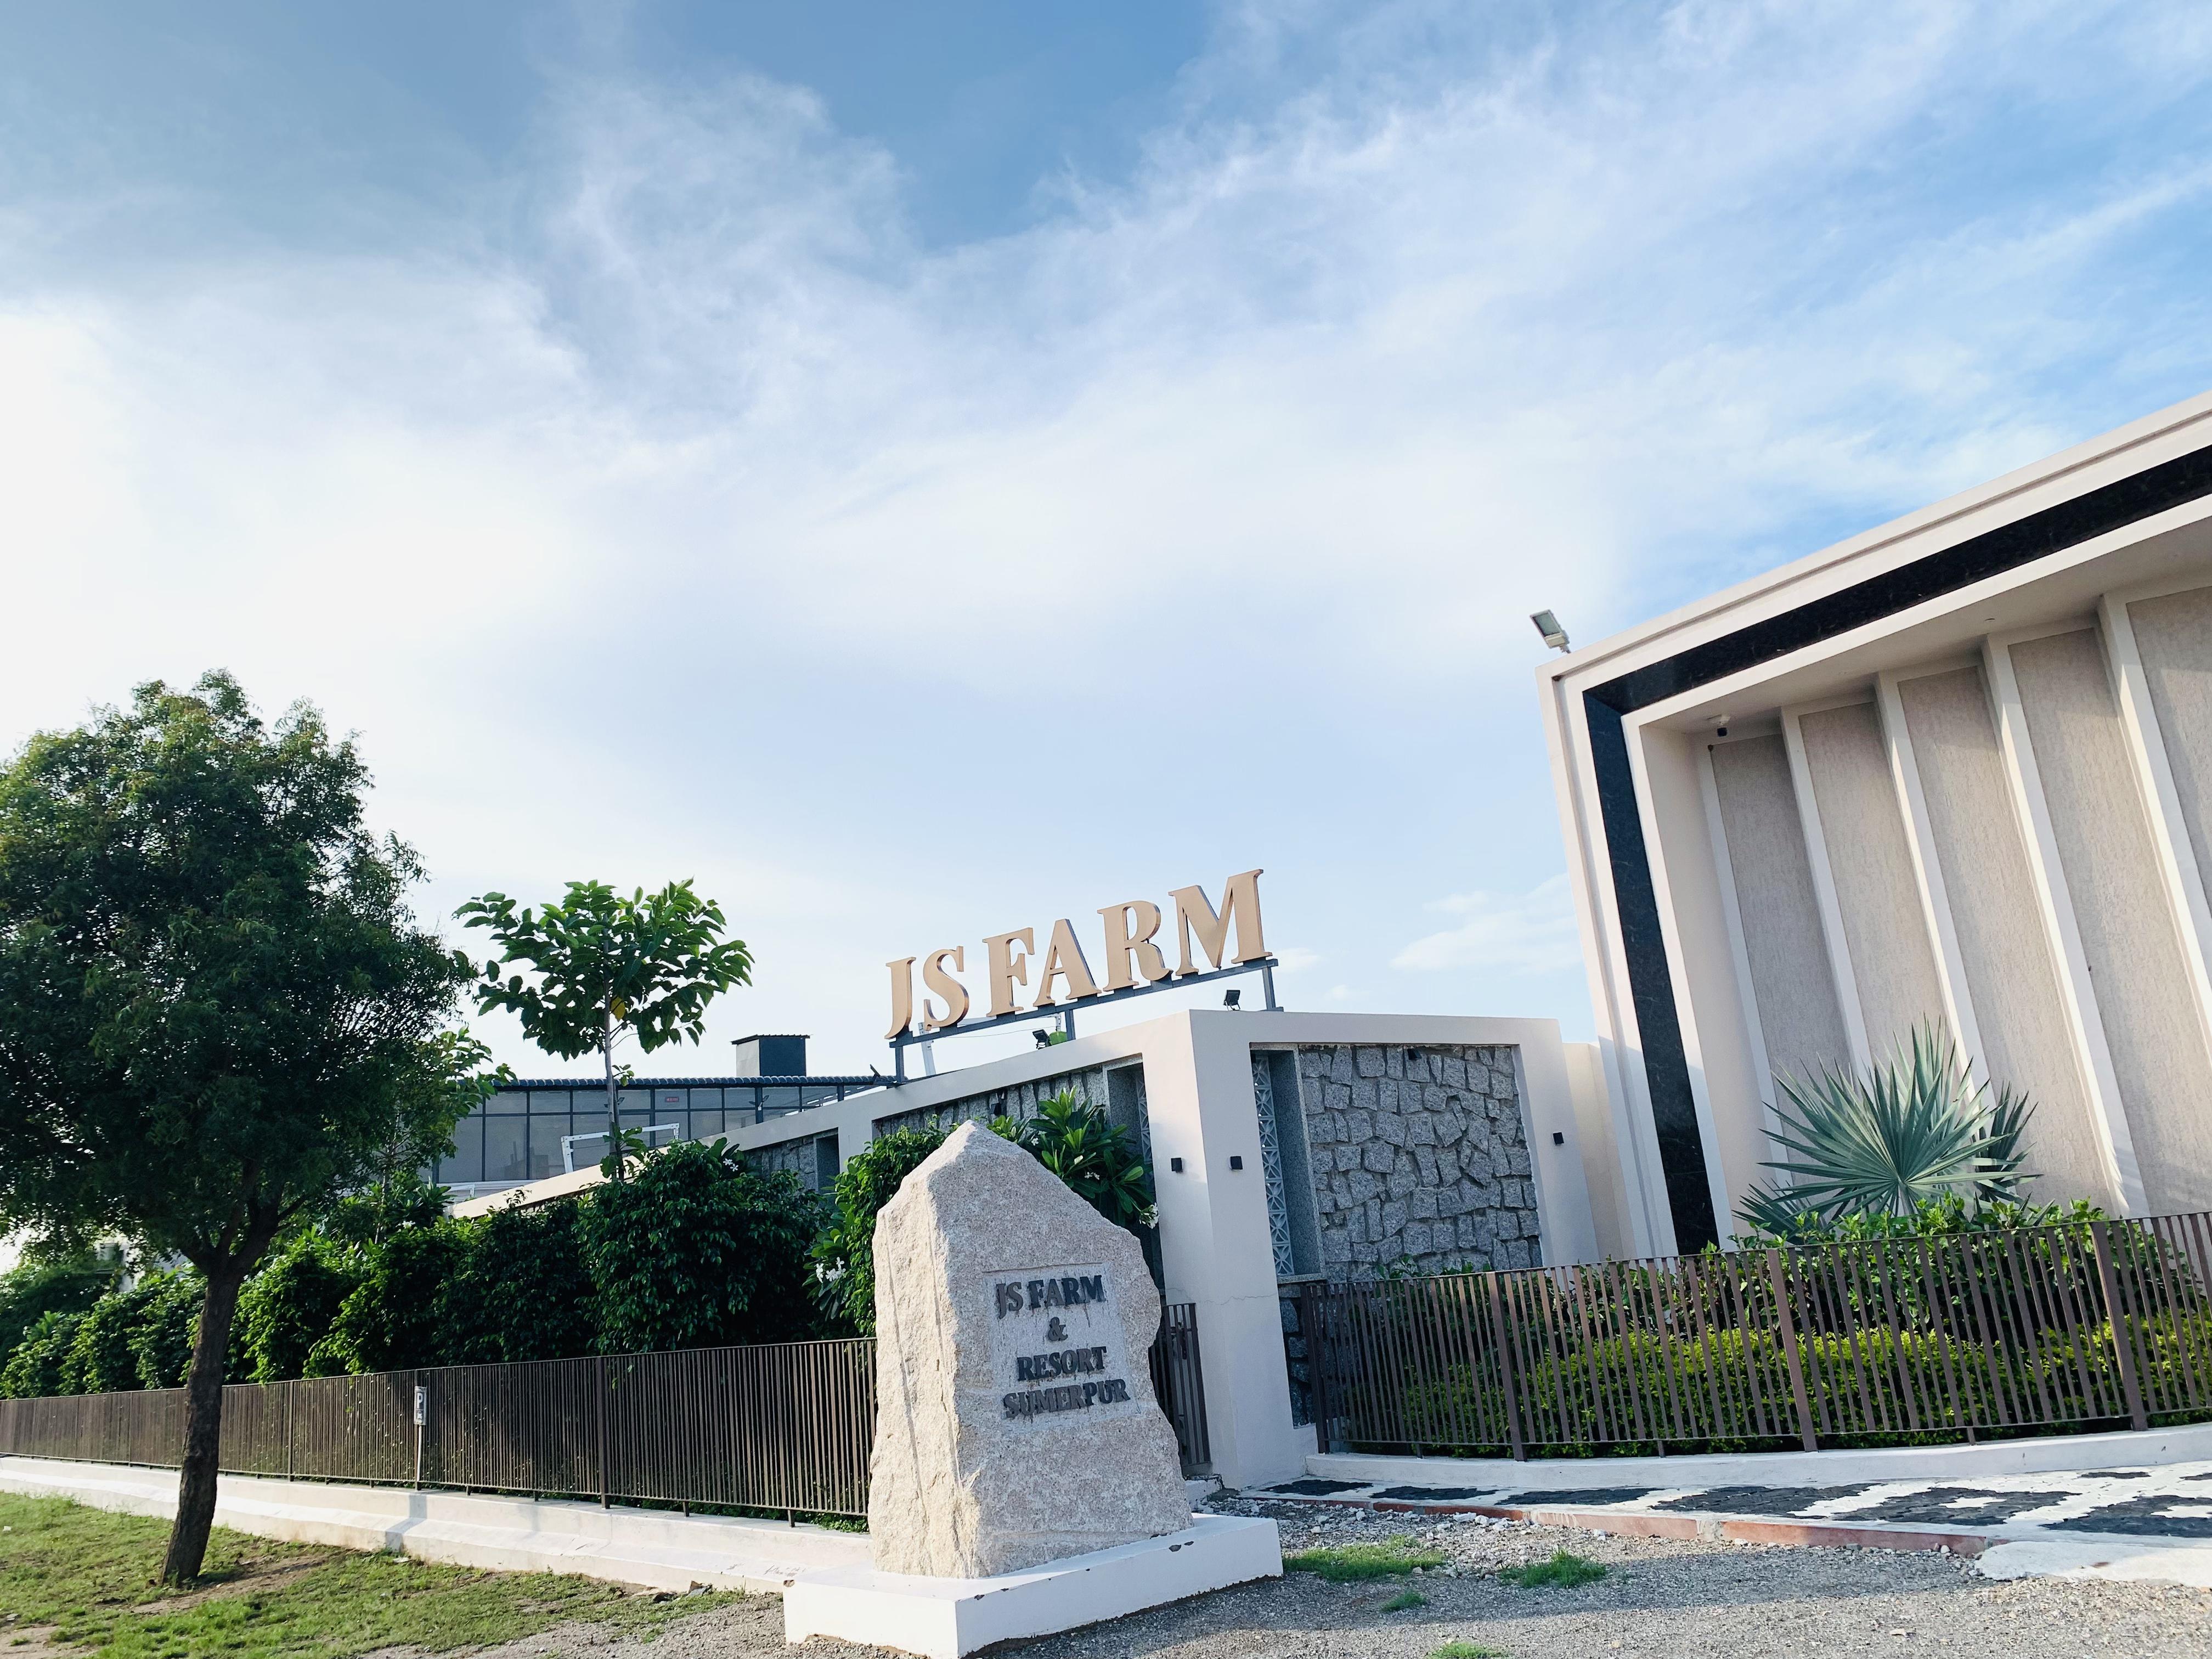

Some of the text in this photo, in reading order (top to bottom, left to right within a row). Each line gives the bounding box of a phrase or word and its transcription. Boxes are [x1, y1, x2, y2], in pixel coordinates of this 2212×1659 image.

[884, 868, 1273, 1040] JS FARM
[995, 1274, 1105, 1319] JS FARM
[1047, 1317, 1068, 1341] &
[1017, 1346, 1107, 1381] RESORT
[417, 1392, 423, 1409] P
[1003, 1378, 1131, 1418] SUMERPUR
